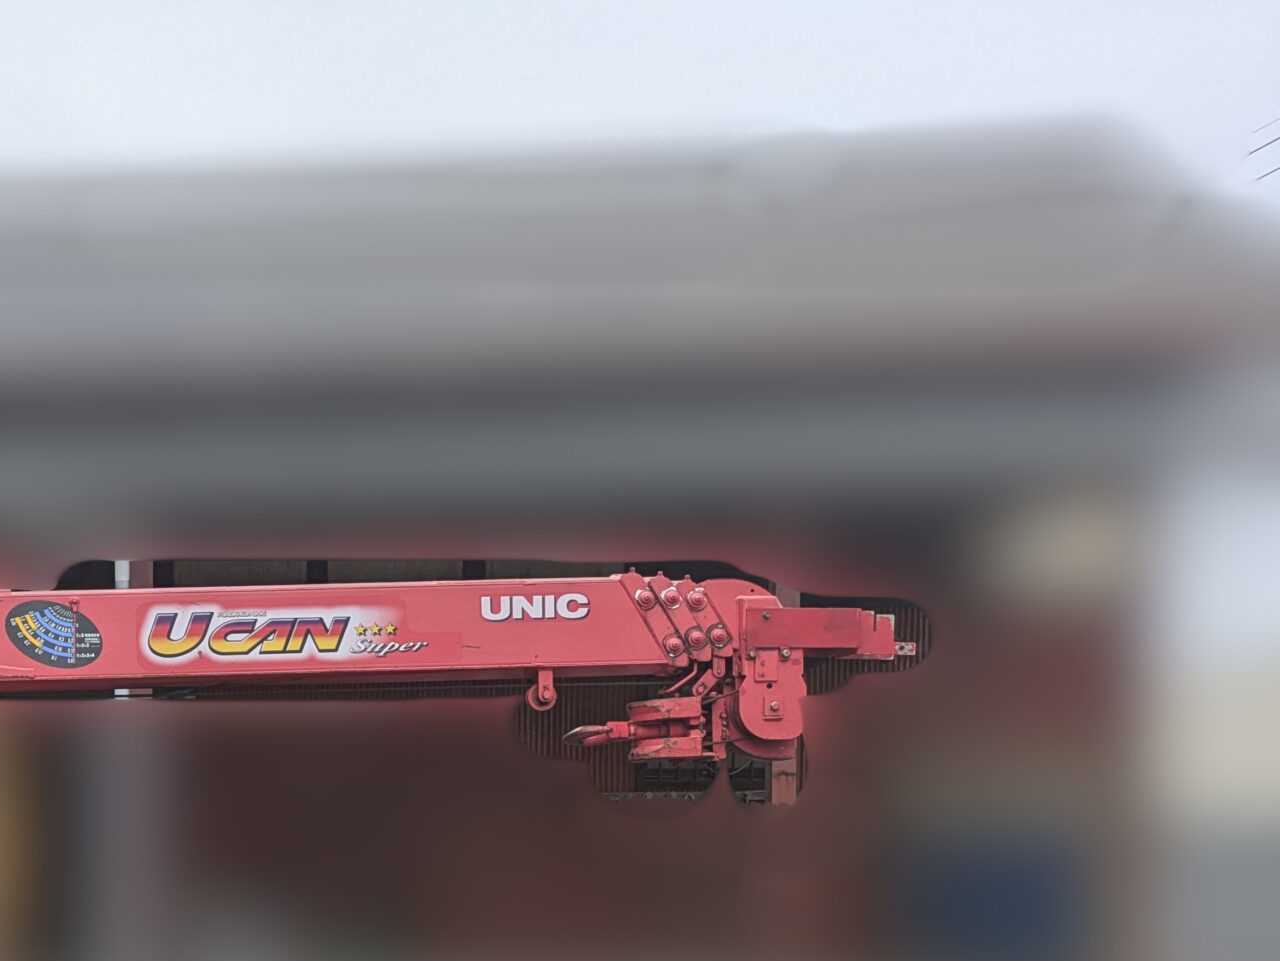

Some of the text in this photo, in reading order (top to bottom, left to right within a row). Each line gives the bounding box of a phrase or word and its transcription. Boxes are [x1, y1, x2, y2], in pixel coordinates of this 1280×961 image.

[480, 593, 590, 621] UNIC
[148, 611, 351, 658] UCAN
[350, 639, 429, 657] Super
